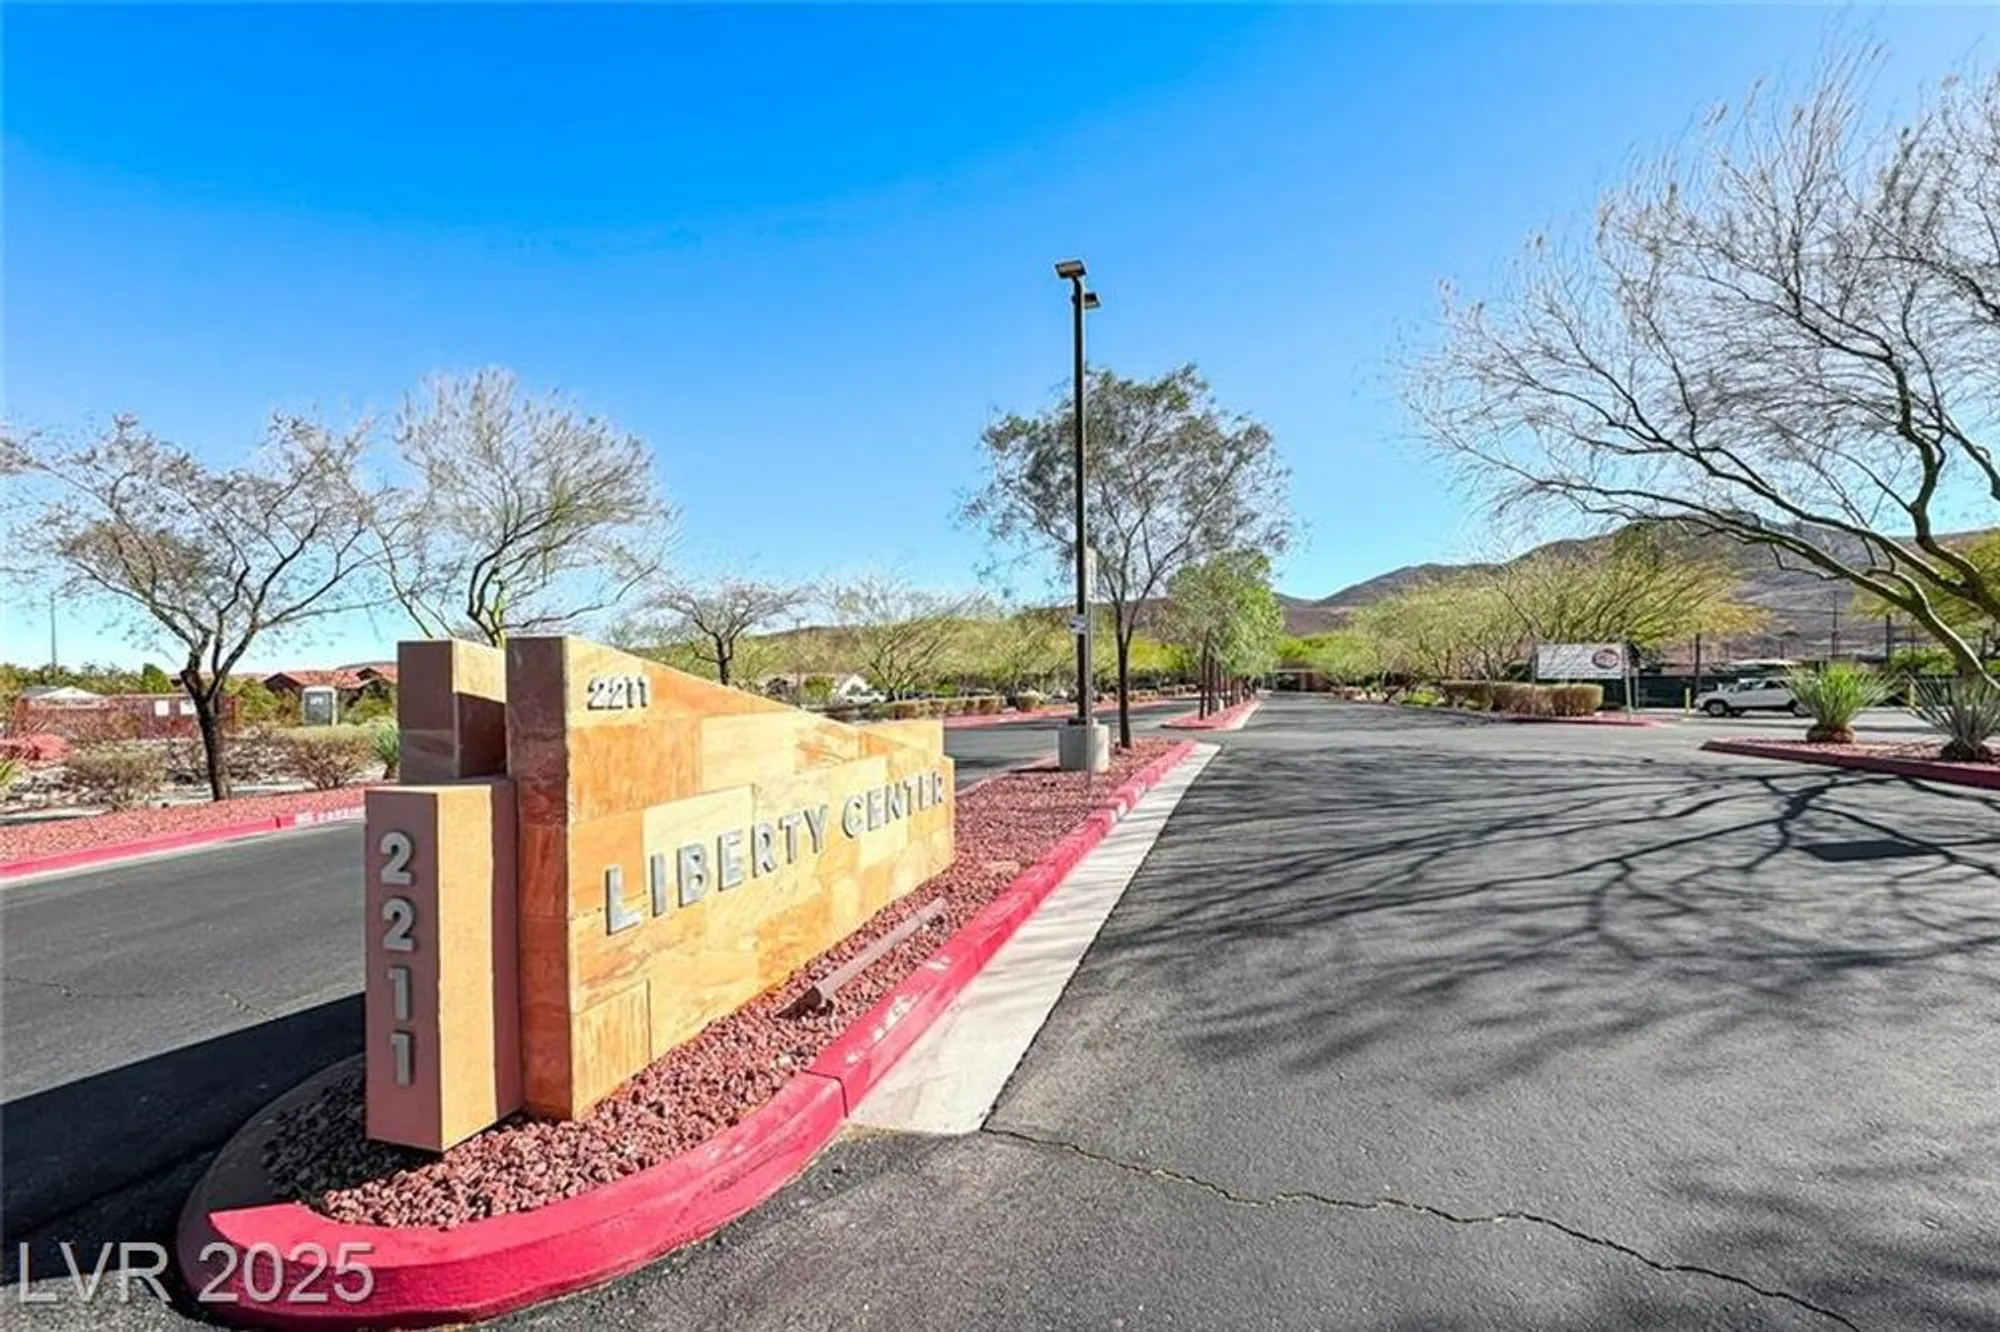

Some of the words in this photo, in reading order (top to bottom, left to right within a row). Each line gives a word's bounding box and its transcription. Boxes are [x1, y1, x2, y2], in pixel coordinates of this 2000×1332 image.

[587, 676, 647, 711] 2211
[605, 803, 829, 936] LIBERTY
[842, 771, 944, 840] CENTER
[379, 831, 415, 1087] 2211
